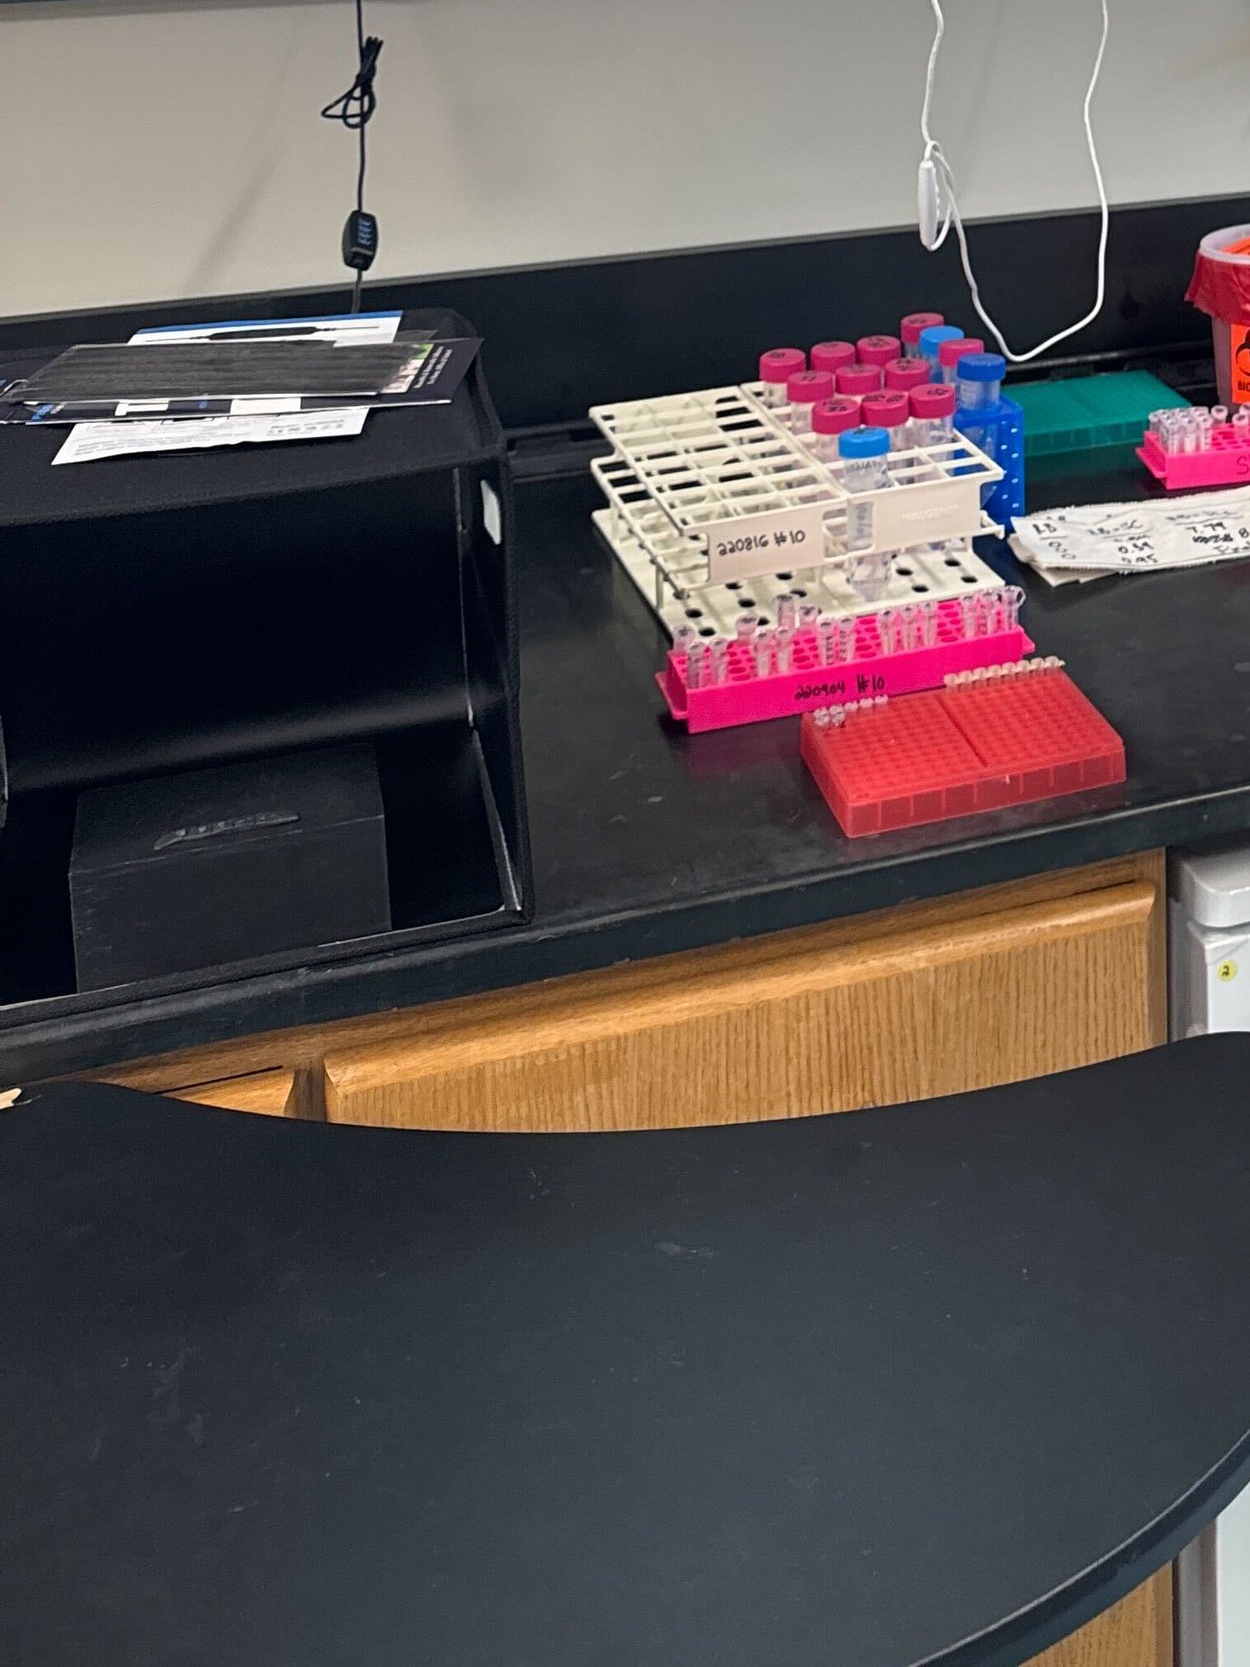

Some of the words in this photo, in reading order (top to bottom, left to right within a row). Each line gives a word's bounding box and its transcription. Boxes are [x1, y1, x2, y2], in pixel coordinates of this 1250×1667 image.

[716, 534, 769, 556] 220816
[774, 529, 806, 548] #10
[795, 681, 845, 701] 220904
[856, 674, 886, 692] #10
